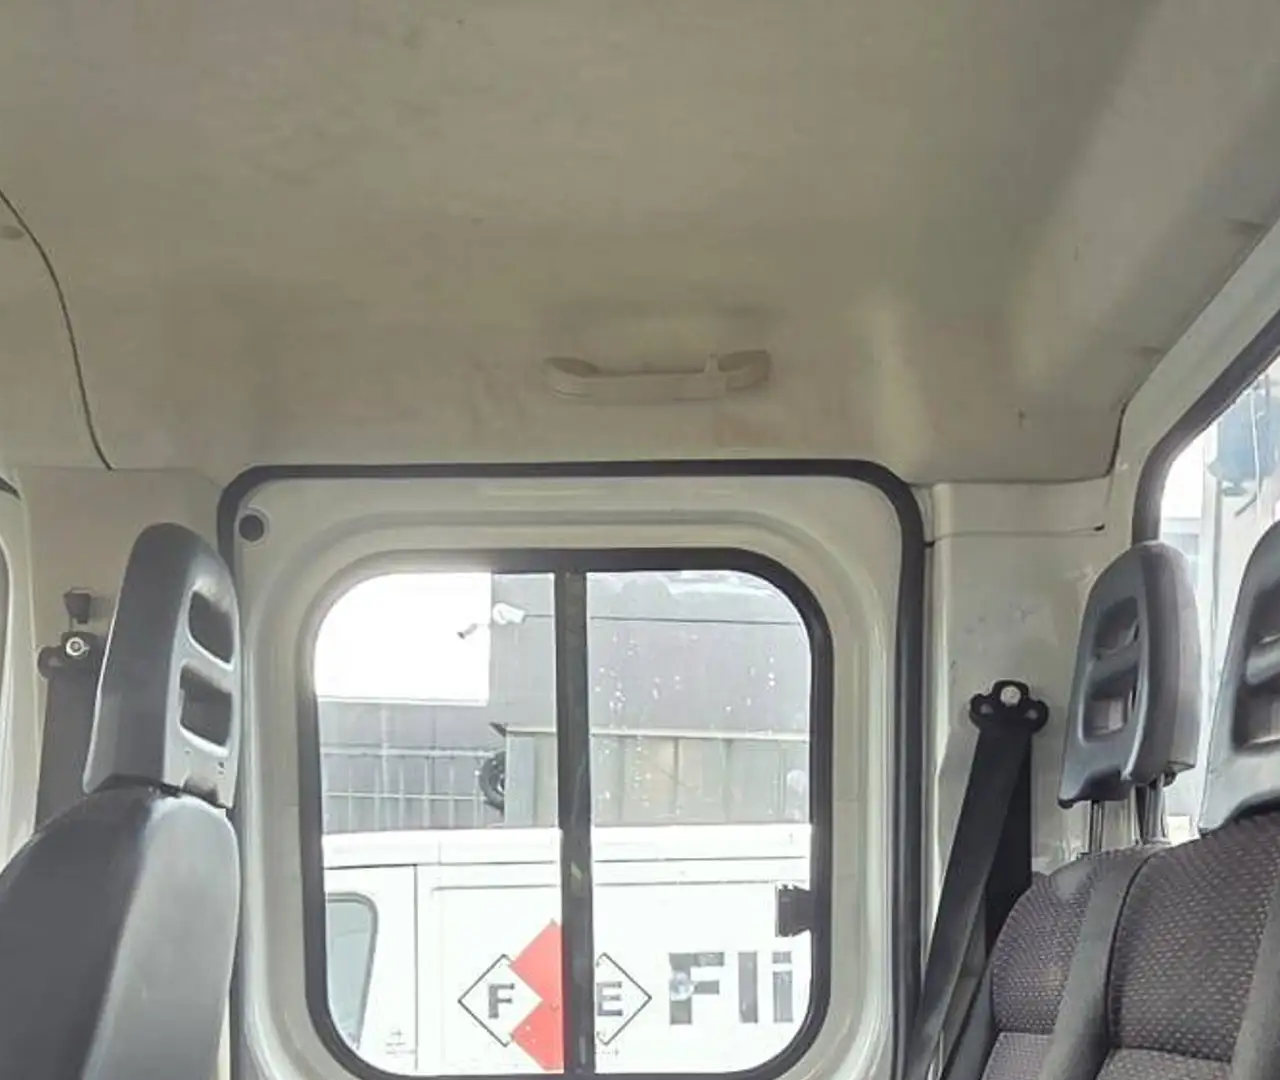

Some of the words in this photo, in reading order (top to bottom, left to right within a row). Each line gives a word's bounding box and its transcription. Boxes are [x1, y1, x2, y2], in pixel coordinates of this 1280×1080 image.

[487, 982, 516, 1020] F
[595, 980, 624, 1018] E
[668, 951, 795, 1026] Fli
